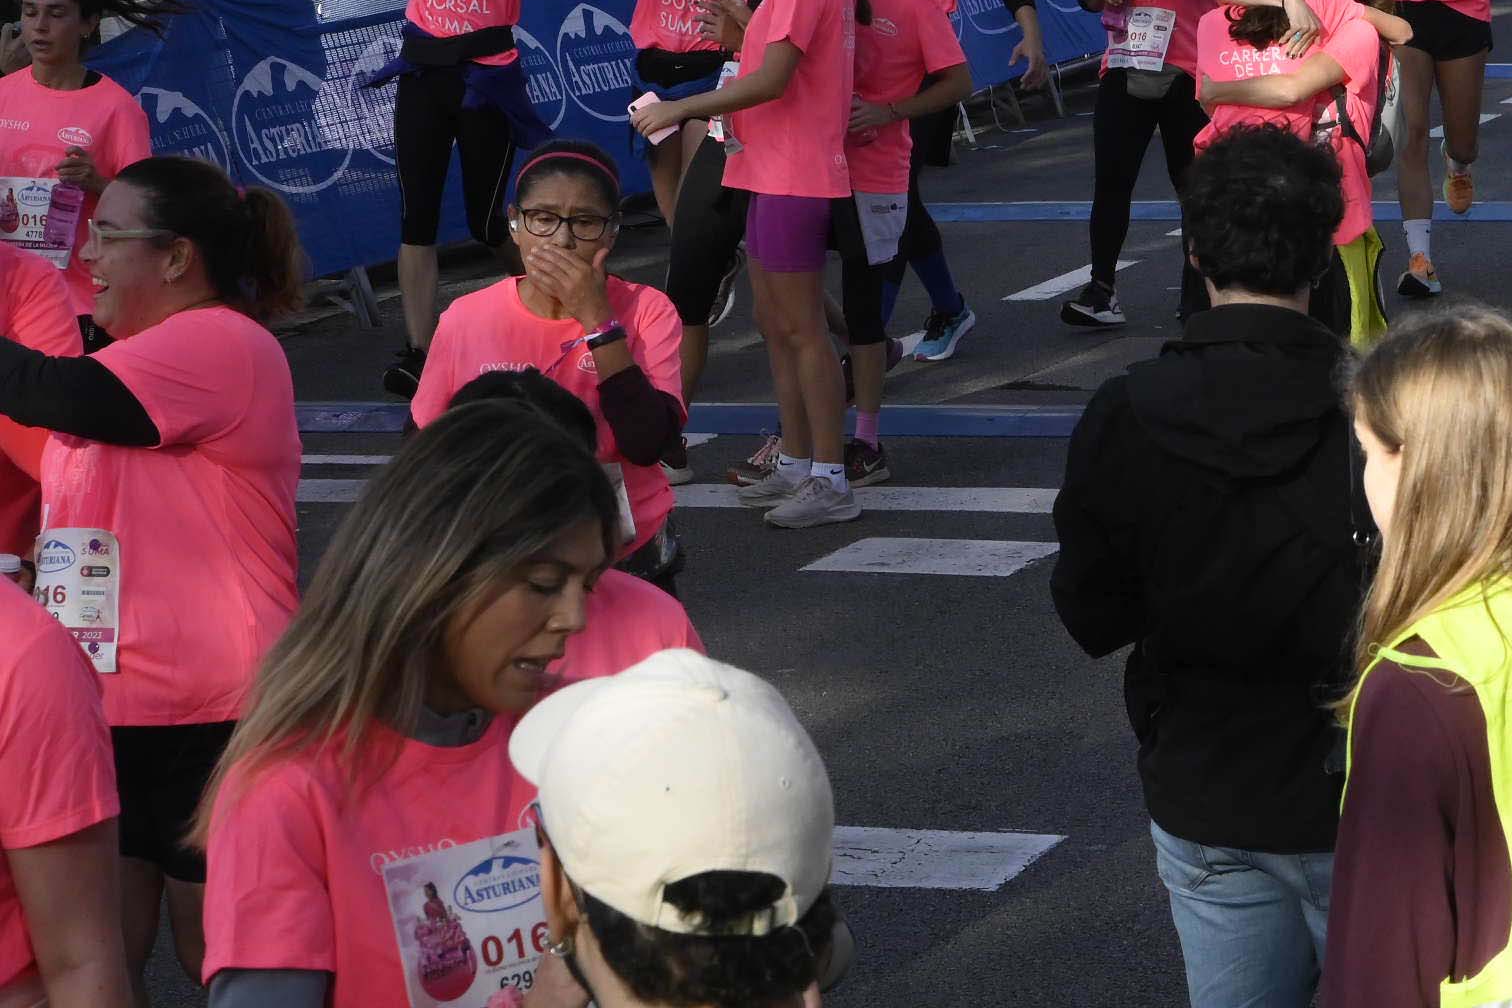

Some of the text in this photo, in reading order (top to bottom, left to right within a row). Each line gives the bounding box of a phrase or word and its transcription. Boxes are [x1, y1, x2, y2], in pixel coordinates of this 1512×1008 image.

[1130, 31, 1147, 41] 016
[1234, 62, 1281, 78] DE LA
[21, 213, 48, 226] 016
[481, 920, 550, 967] 016
[500, 969, 538, 990] 629
